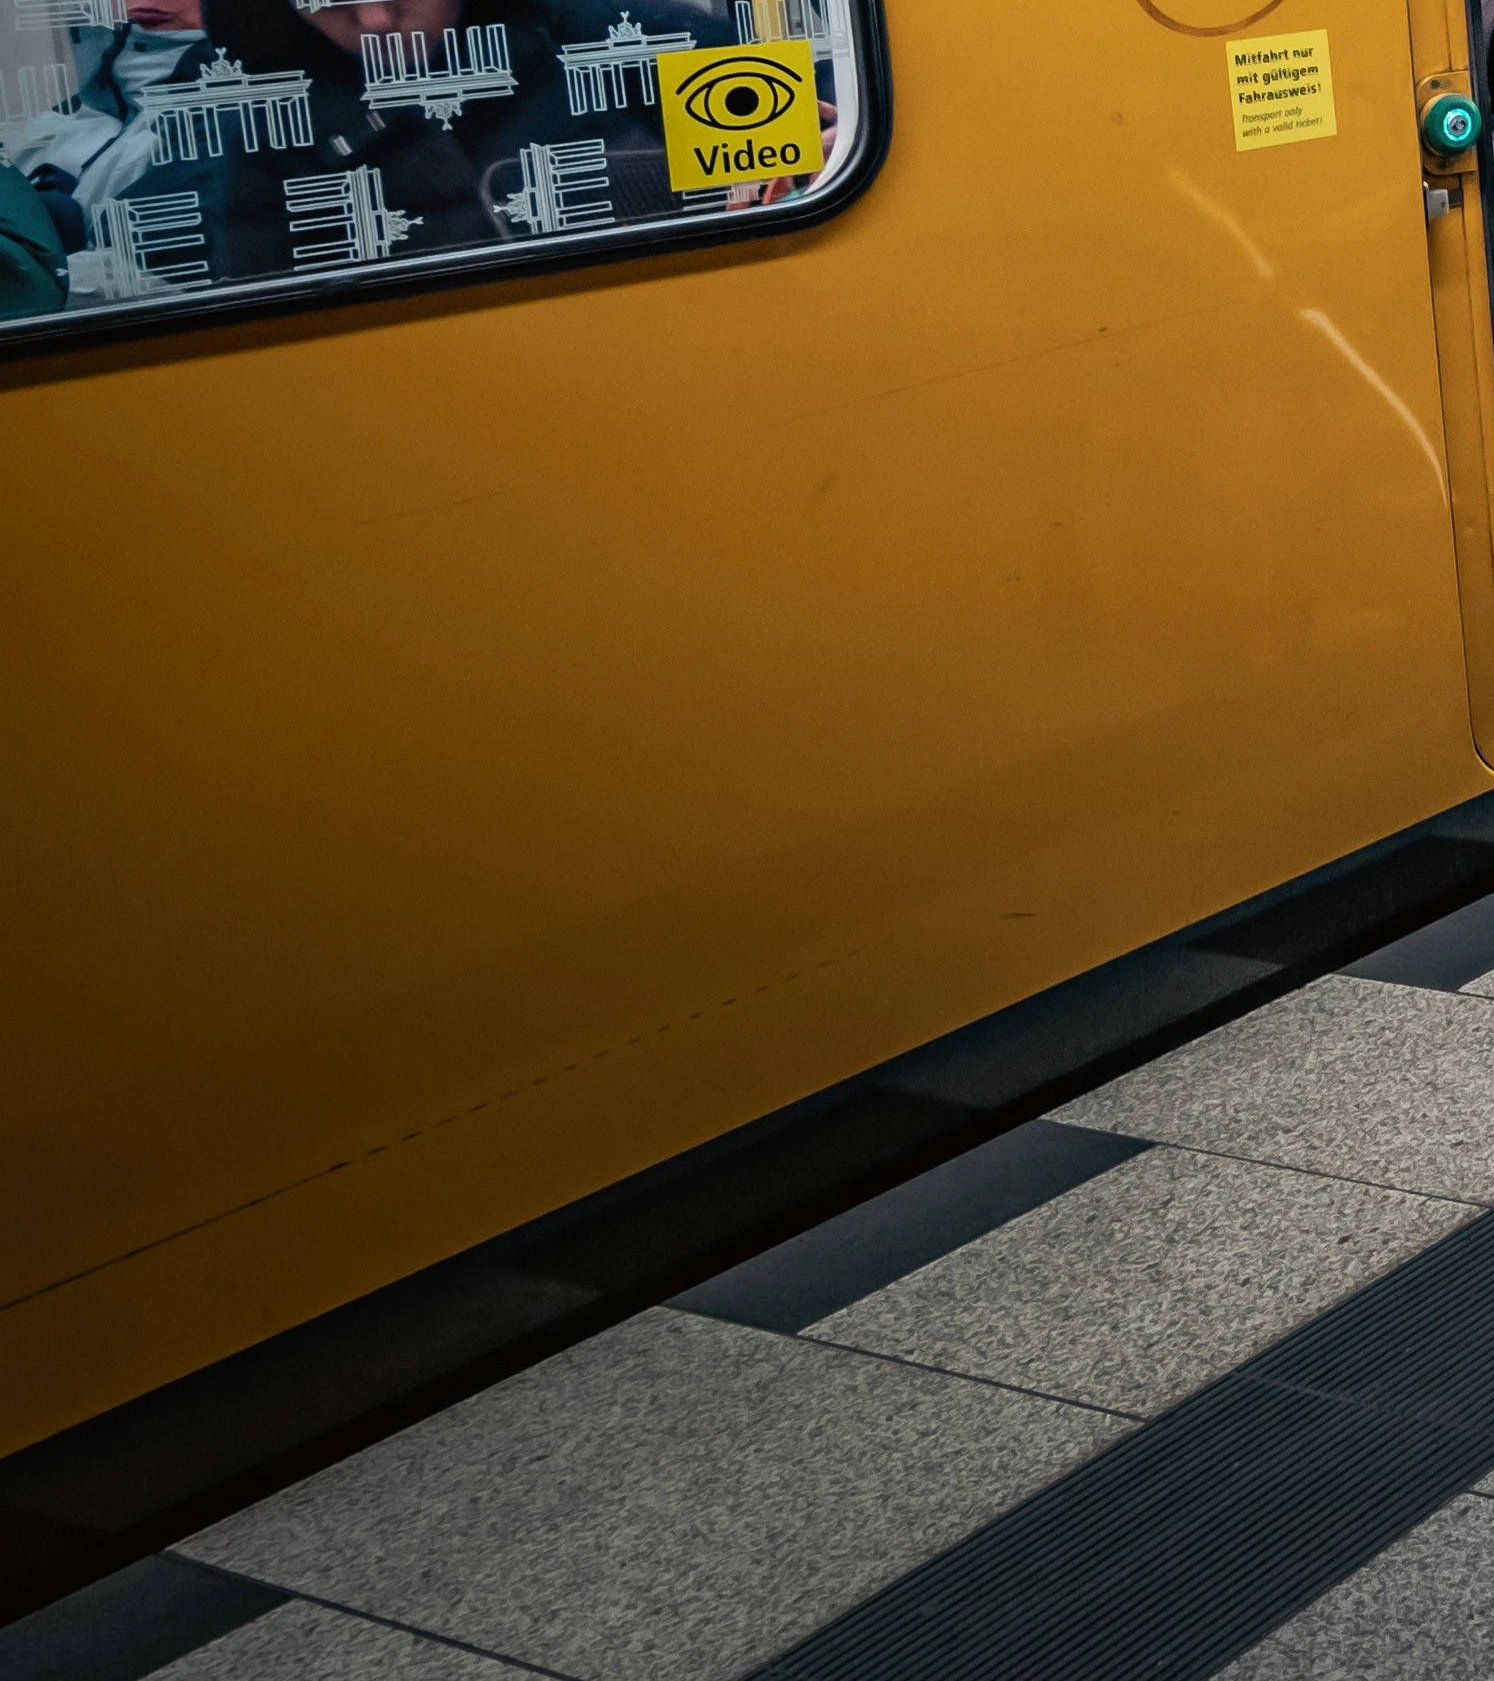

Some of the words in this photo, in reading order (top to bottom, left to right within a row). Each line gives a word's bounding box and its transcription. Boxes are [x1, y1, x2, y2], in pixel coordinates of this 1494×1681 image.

[1234, 50, 1289, 66] Mitfahrt
[1292, 47, 1314, 58] nur
[1236, 72, 1259, 84] mit
[1262, 65, 1319, 85] gültigem
[1238, 83, 1322, 104] Fahrausweis!
[1242, 109, 1282, 124] Transport
[1284, 106, 1303, 118] only
[1242, 126, 1262, 138] with
[1264, 126, 1270, 134] a
[1272, 120, 1294, 132] valid
[693, 139, 801, 176] Video
